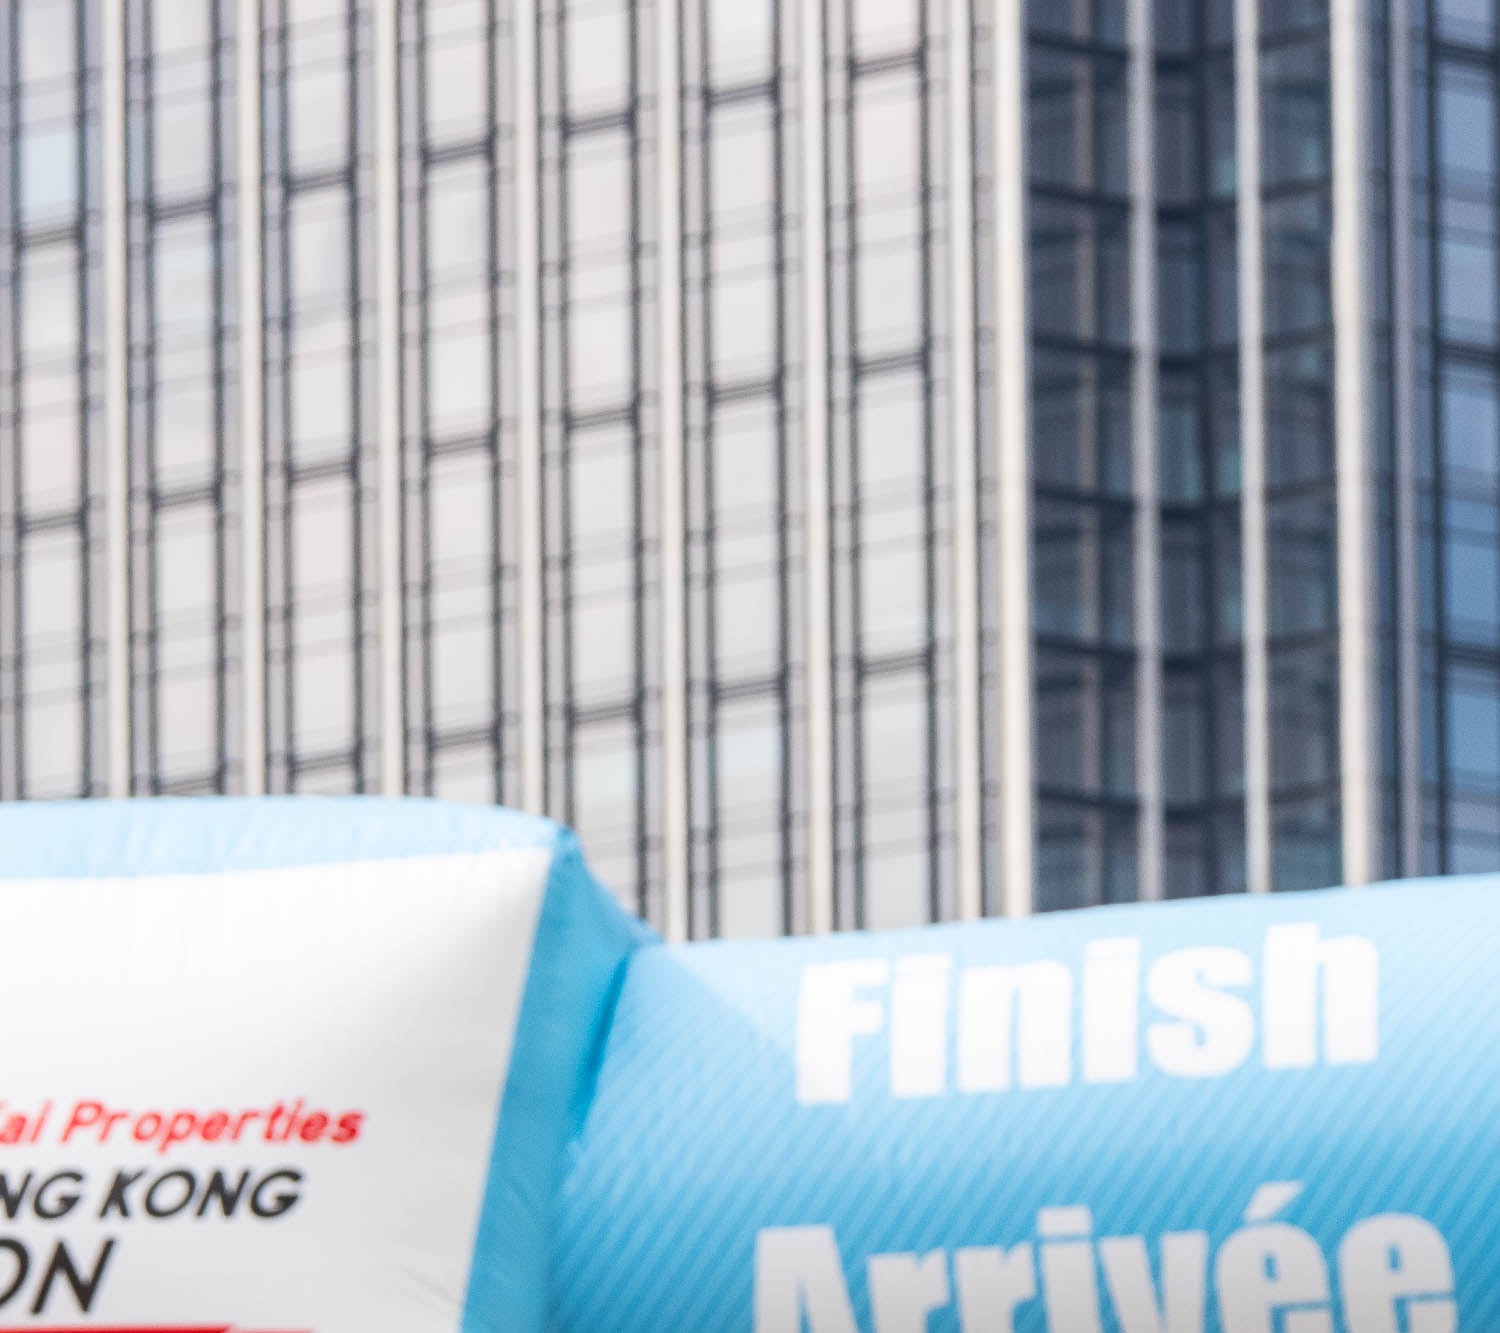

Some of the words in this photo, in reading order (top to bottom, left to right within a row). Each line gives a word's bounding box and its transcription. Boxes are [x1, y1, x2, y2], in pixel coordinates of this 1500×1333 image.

[796, 922, 1378, 1105] Finish
[59, 1097, 366, 1152] Properties
[97, 1166, 306, 1220] KONG
